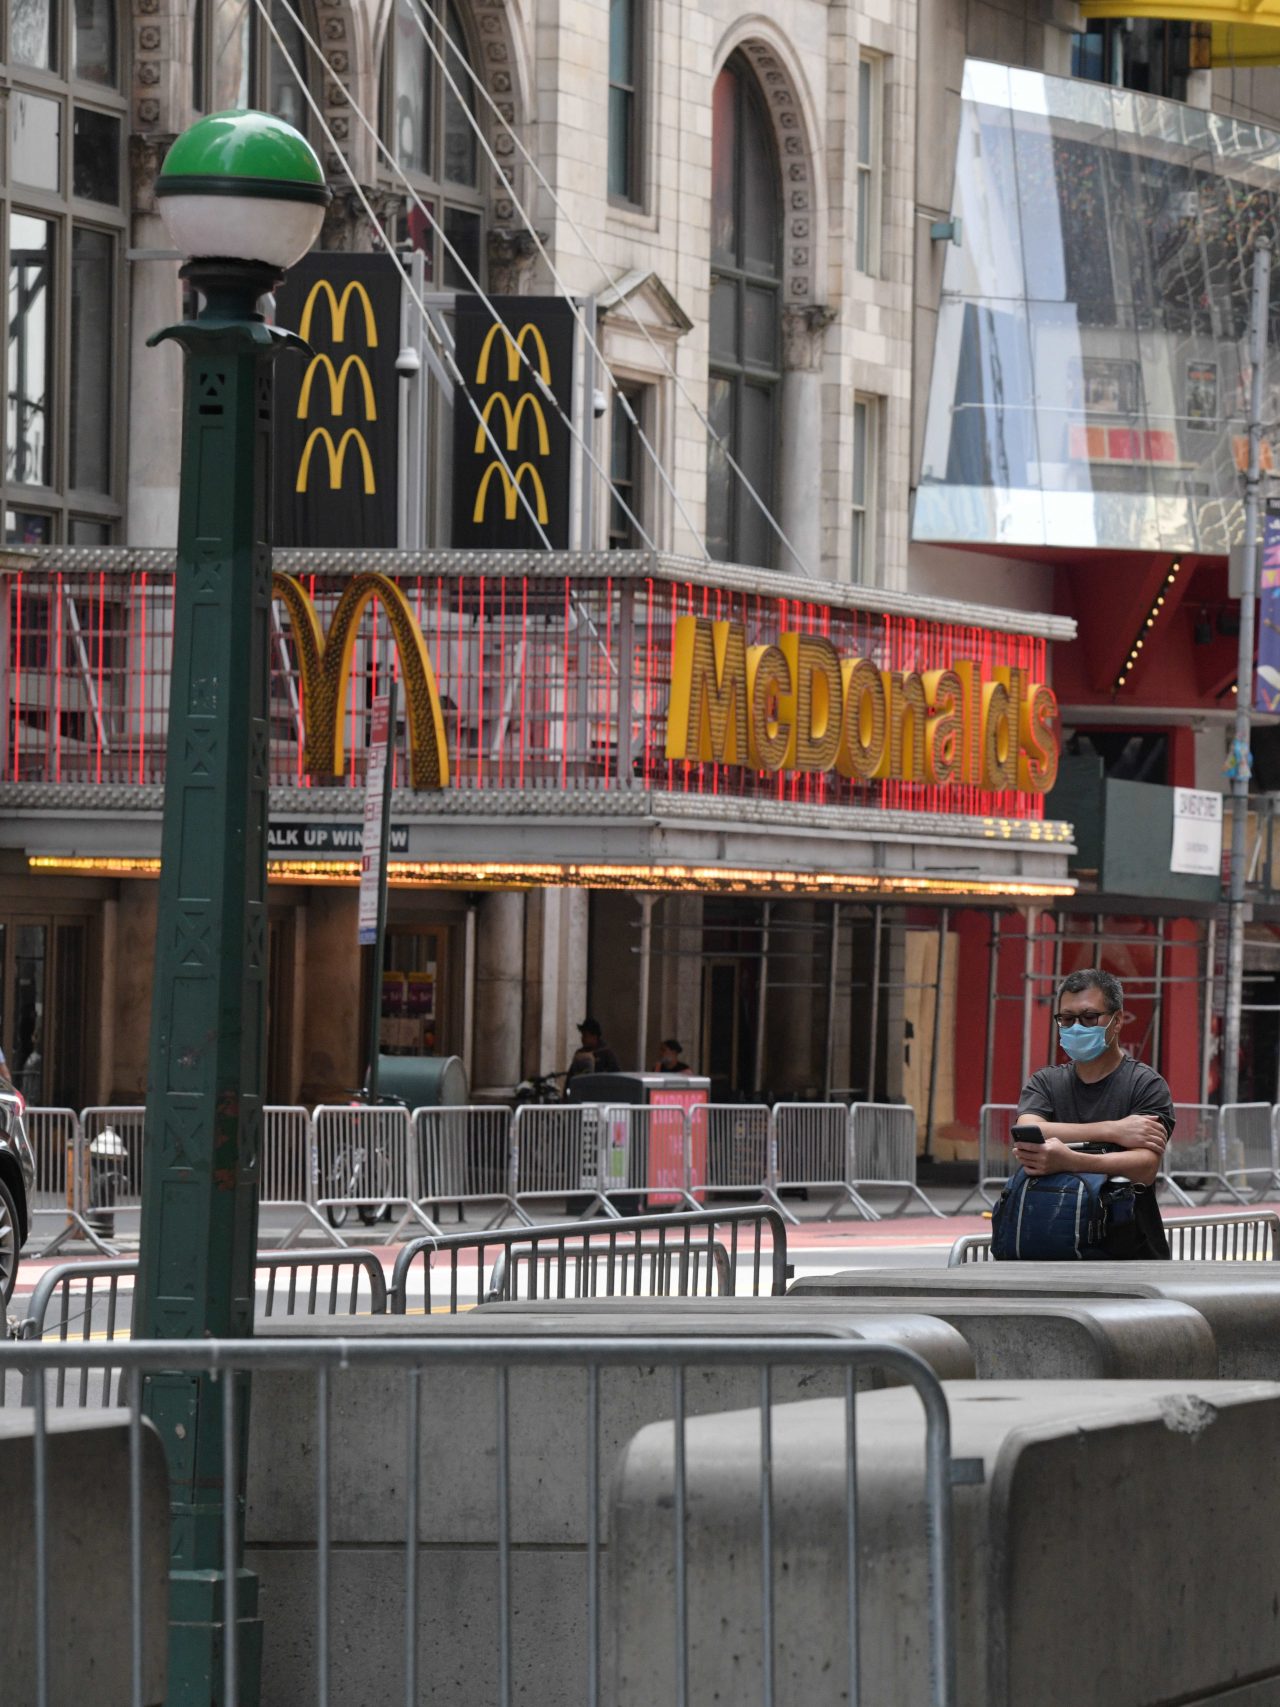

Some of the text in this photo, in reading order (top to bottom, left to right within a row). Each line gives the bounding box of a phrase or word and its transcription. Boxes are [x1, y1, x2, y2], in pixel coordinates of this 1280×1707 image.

[665, 615, 1059, 793] McDonald's
[267, 830, 407, 847] ALK UP WINW
